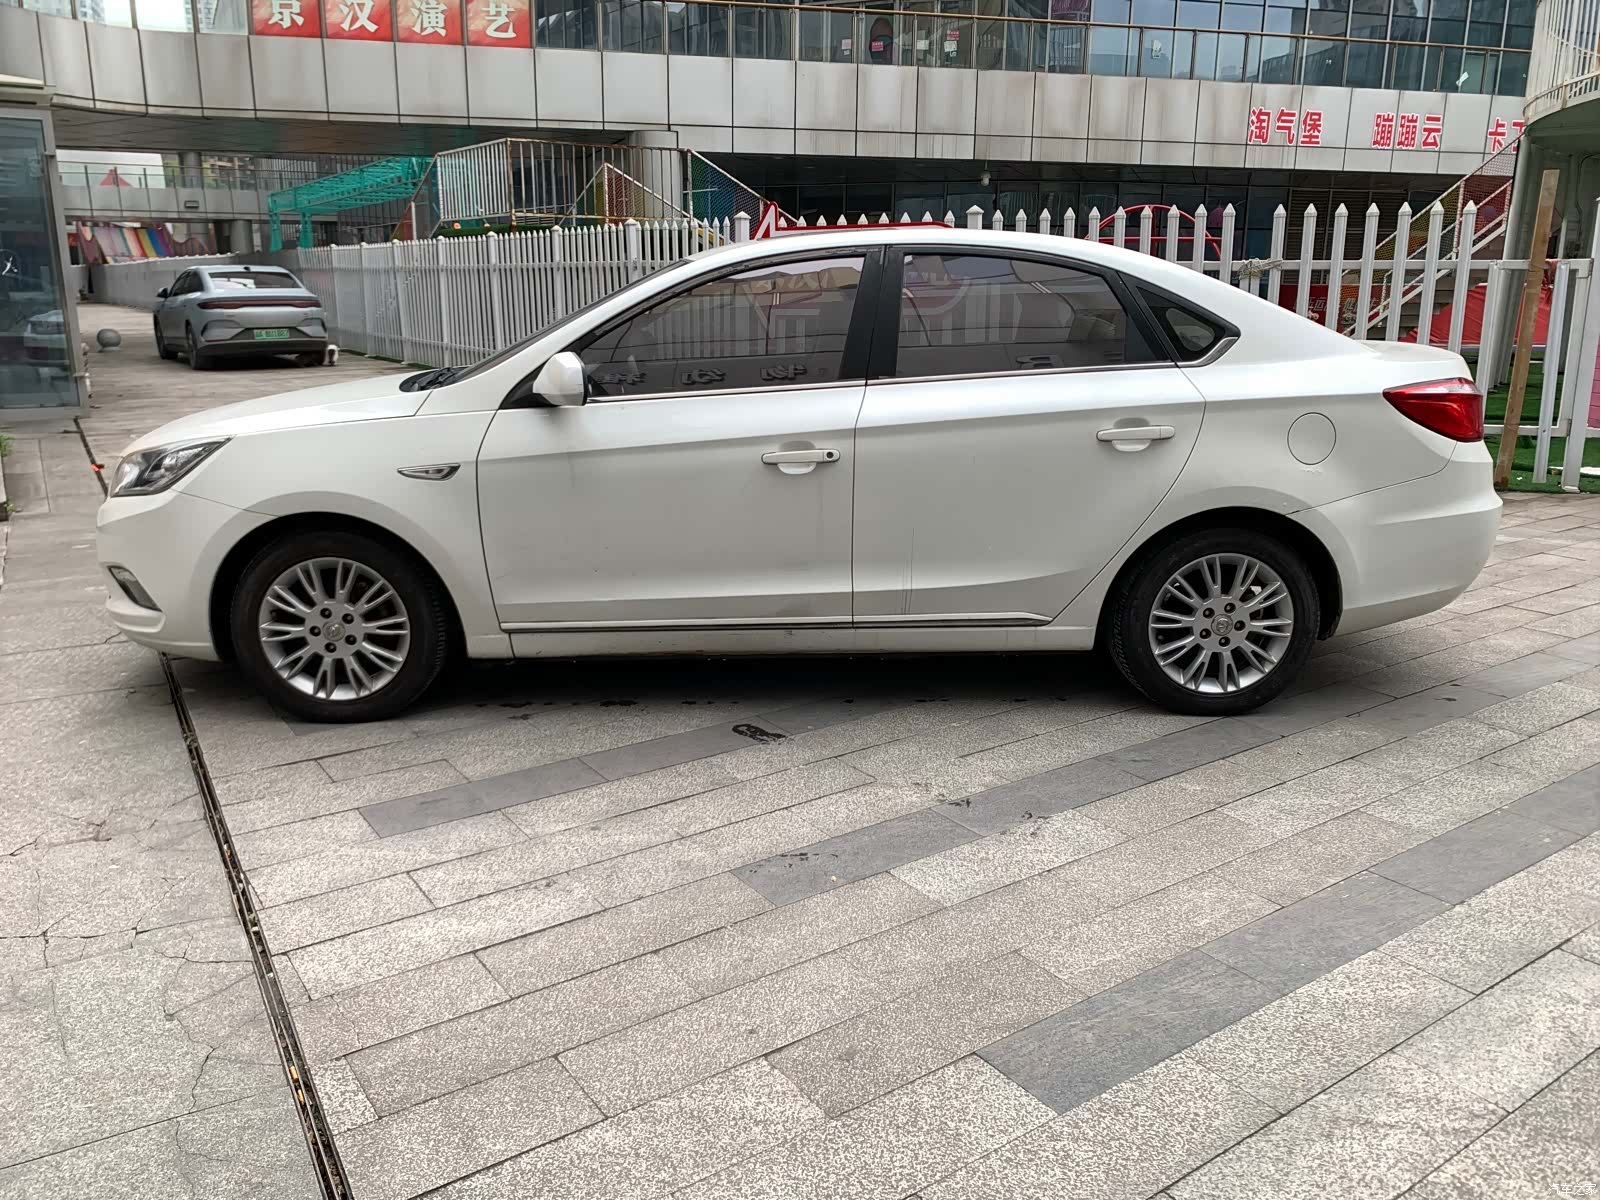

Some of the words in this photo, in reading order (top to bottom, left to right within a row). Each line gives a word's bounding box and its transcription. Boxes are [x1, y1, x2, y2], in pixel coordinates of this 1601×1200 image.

[1248, 107, 1323, 146] 淘气堡
[1371, 112, 1443, 150] 蹦蹦云
